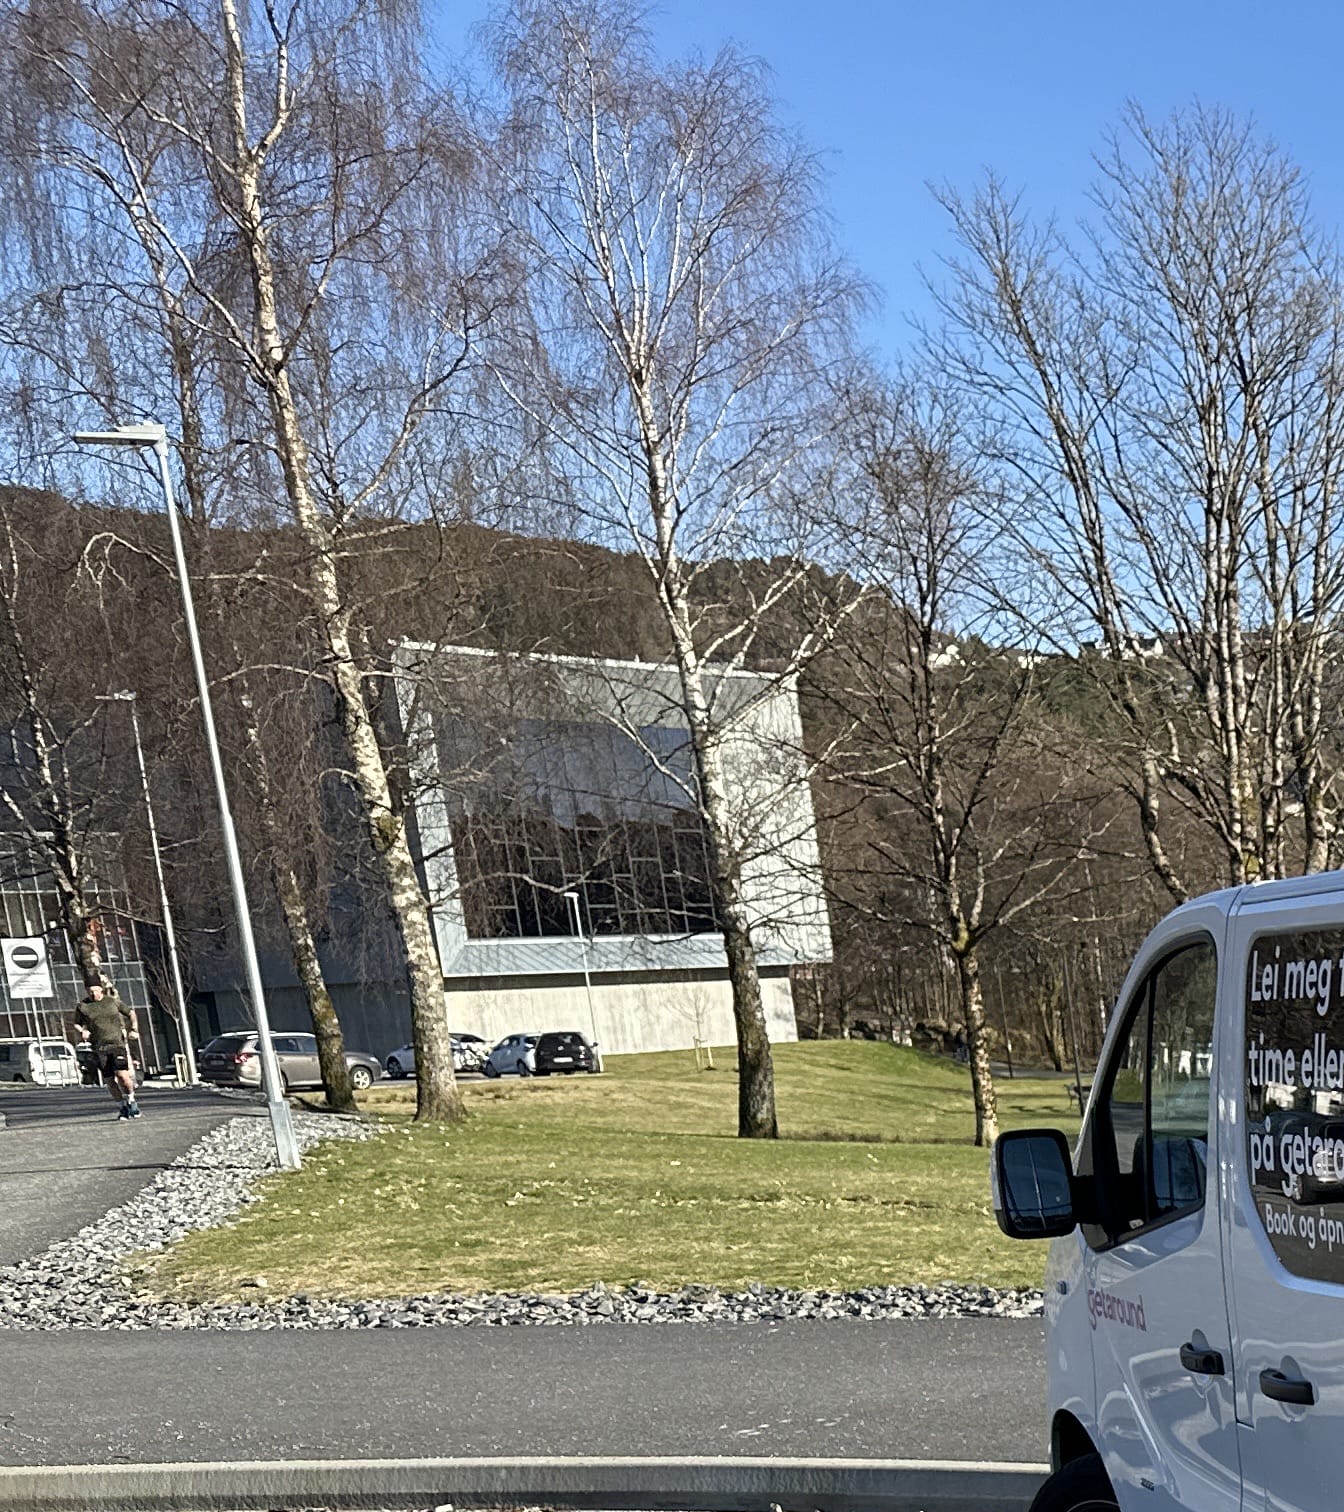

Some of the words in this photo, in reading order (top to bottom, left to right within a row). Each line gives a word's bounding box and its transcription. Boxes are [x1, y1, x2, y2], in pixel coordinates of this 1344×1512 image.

[1251, 945, 1280, 1001] Lei
[1284, 958, 1332, 1016] meg
[1249, 1032, 1295, 1087] time
[1250, 1115, 1274, 1185] på
[1265, 1203, 1297, 1236] Book
[1299, 1217, 1316, 1249] og
[1087, 1287, 1147, 1332] getaround
